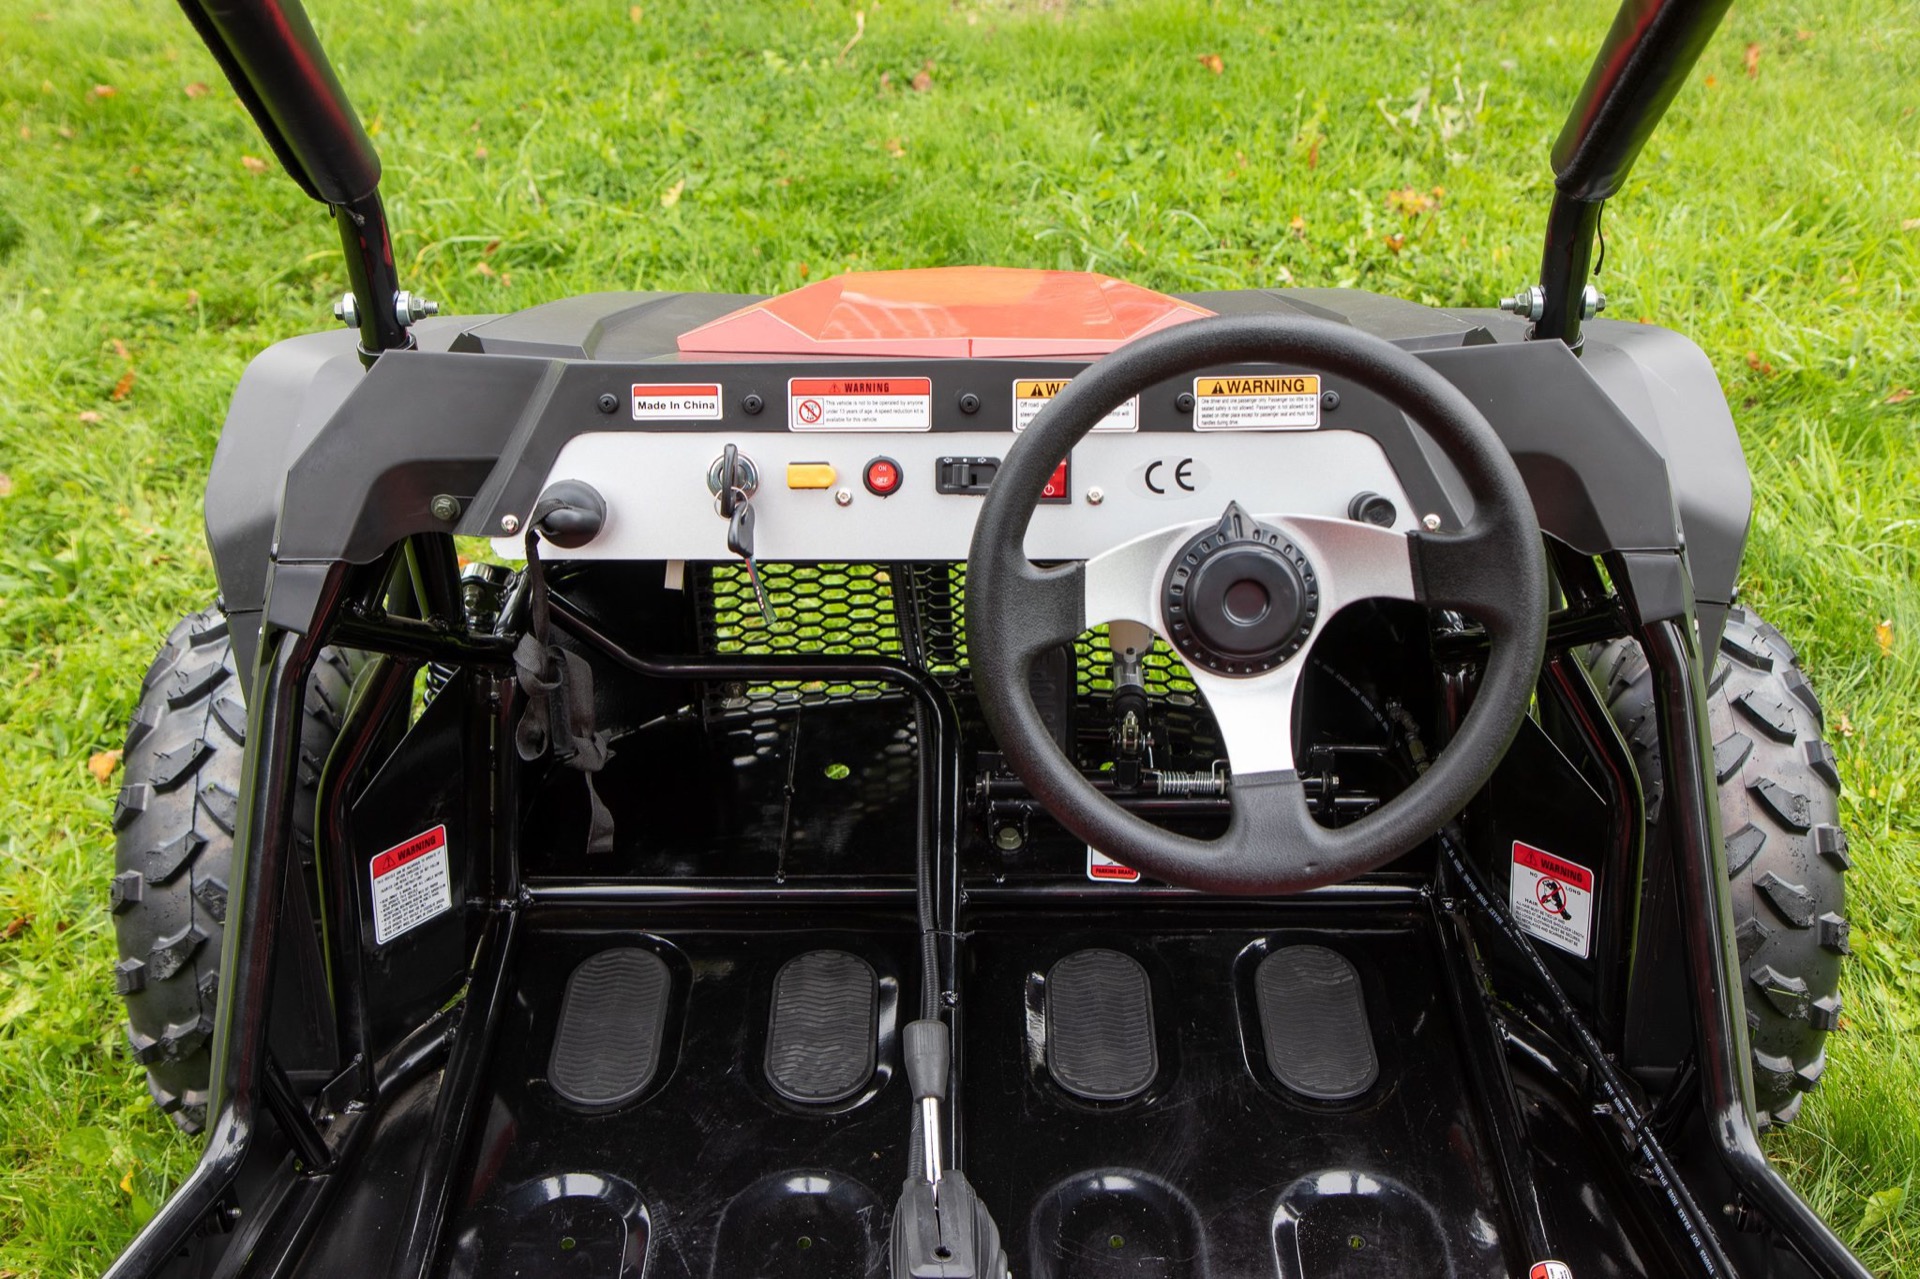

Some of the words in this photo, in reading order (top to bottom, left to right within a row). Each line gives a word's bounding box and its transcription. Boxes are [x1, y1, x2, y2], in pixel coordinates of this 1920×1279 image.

[844, 382, 890, 392] WARNING
[1227, 378, 1304, 394] WARNING
[638, 401, 666, 410] Made
[670, 401, 680, 409] In
[684, 400, 715, 409] China
[876, 476, 889, 484] OFF
[397, 834, 435, 861] WARNING
[1540, 857, 1582, 882] WARNING
[1565, 885, 1580, 895] LONG
[1524, 897, 1537, 906] HAIR
[1678, 1208, 1692, 1231] BRAKE
[1690, 1233, 1700, 1248] DOT
